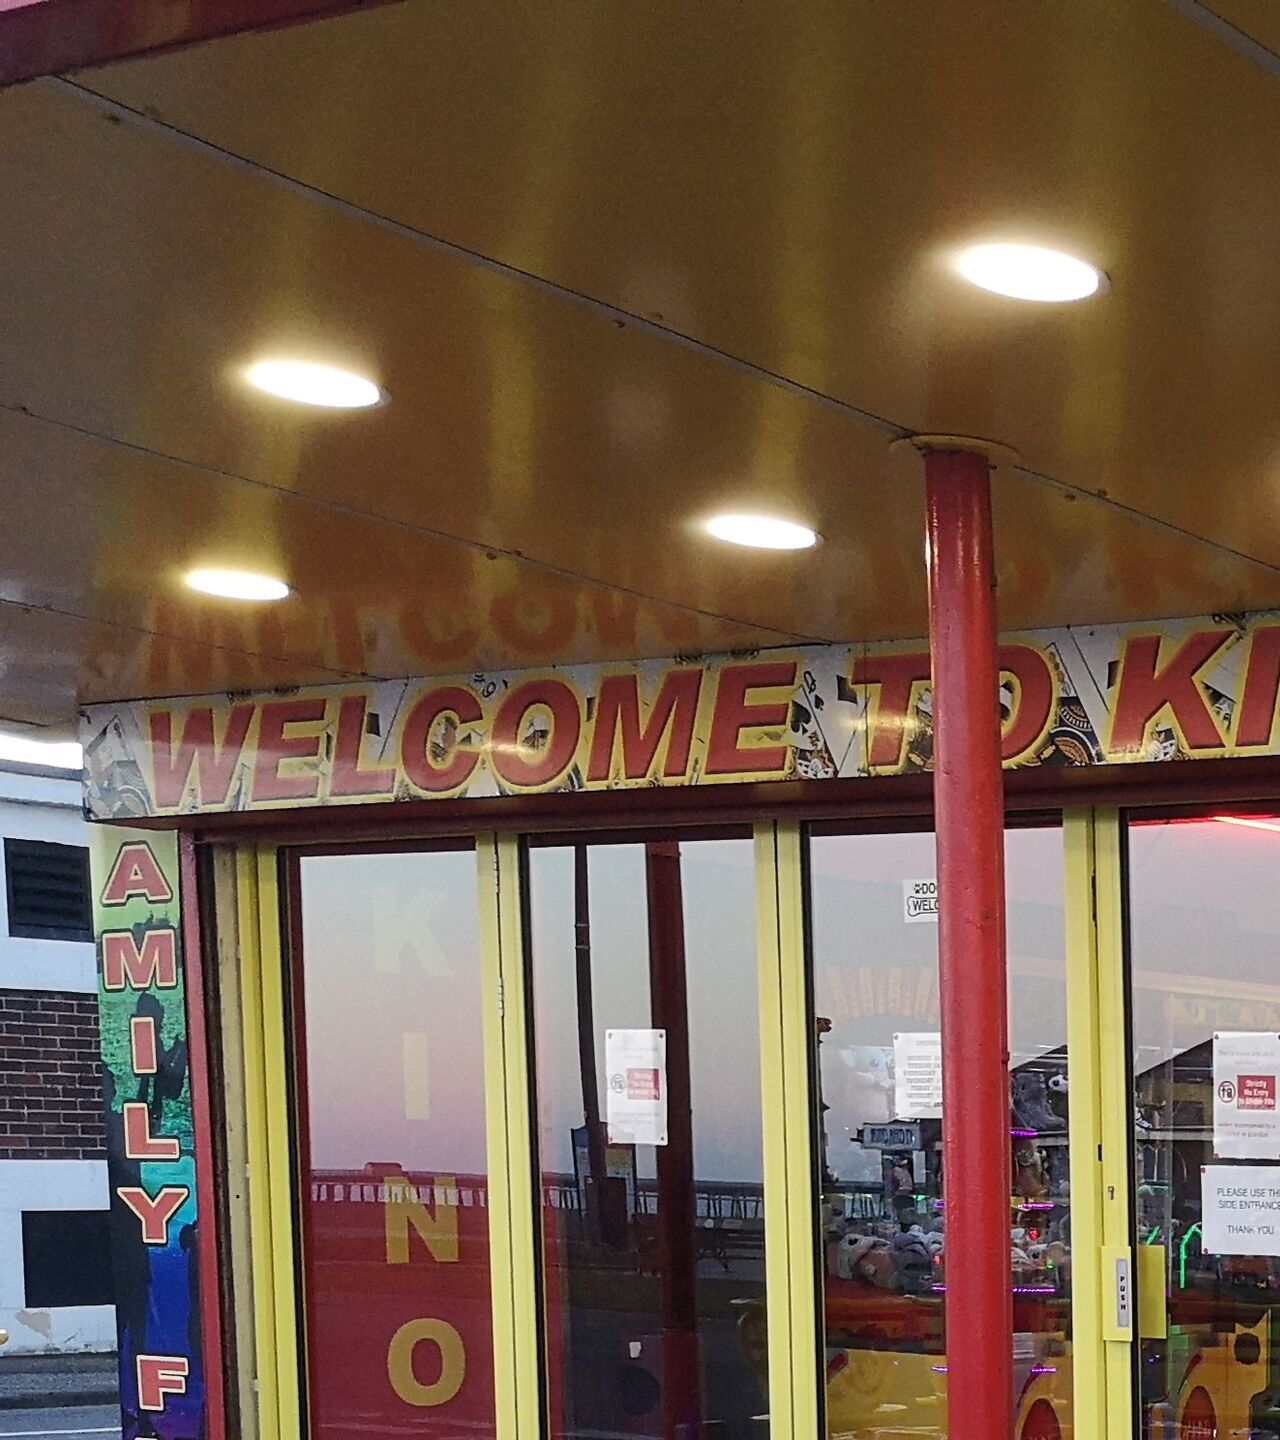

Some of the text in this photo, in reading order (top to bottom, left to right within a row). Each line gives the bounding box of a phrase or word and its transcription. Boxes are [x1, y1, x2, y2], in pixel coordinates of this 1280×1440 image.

[148, 660, 799, 808] WELCOME
[374, 886, 466, 1407] KINO
[1217, 1188, 1248, 1197] PLEASE
[1250, 1188, 1266, 1197] USE
[1219, 1200, 1237, 1209] SIDE
[1227, 1225, 1274, 1235] THANK YOU
